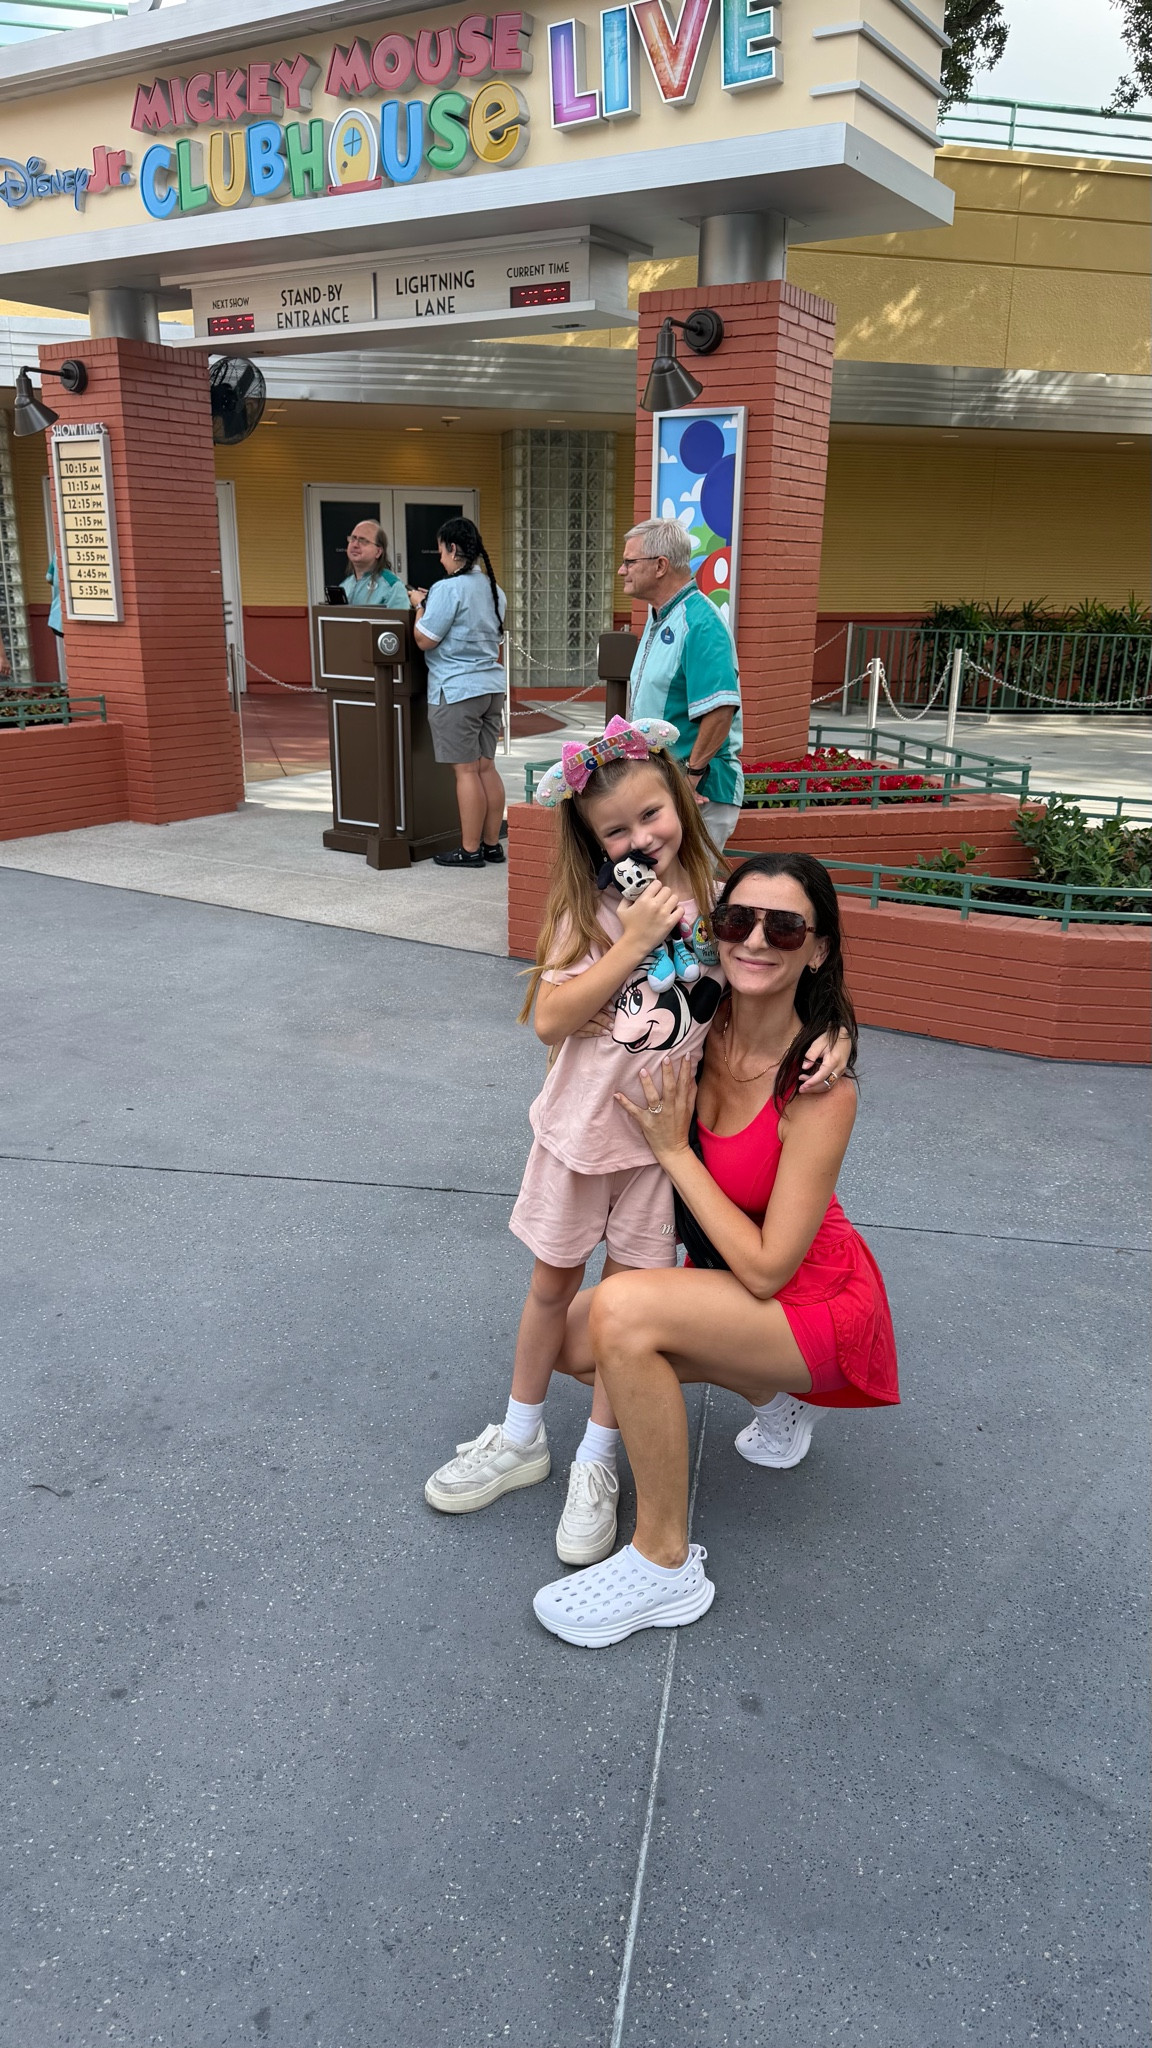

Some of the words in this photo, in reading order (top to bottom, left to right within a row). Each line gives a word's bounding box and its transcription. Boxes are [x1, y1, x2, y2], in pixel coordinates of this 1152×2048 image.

[130, 52, 311, 132] MICKEY
[324, 11, 523, 97] MOUSE
[547, 0, 781, 130] LIVE
[86, 145, 132, 193] Jr.
[506, 263, 545, 278] CURRENT
[548, 261, 570, 275] TIME
[395, 269, 475, 296] LIGHTNING
[212, 298, 228, 310] NEXT
[229, 296, 250, 308] SHOW
[281, 283, 343, 307] STAND-BY
[415, 295, 456, 317] LANE
[277, 305, 350, 329] ENTRANCE
[51, 422, 106, 437] SHOWTIMES
[65, 462, 88, 473] 10:15
[89, 465, 99, 473] AM
[67, 480, 89, 492] 11:15
[90, 483, 101, 491] AM
[67, 498, 91, 509] 12:15
[74, 516, 92, 527] 1:15
[74, 533, 94, 544] 3:05
[95, 536, 105, 544] PM
[76, 551, 96, 561] 3:55
[96, 553, 106, 561] PM
[77, 568, 97, 578] 4:45
[97, 571, 107, 579] PM
[79, 585, 98, 595] 5:35
[99, 588, 109, 596] PM
[567, 729, 634, 770] BIRTHDAY
[585, 746, 626, 770] GIRL
